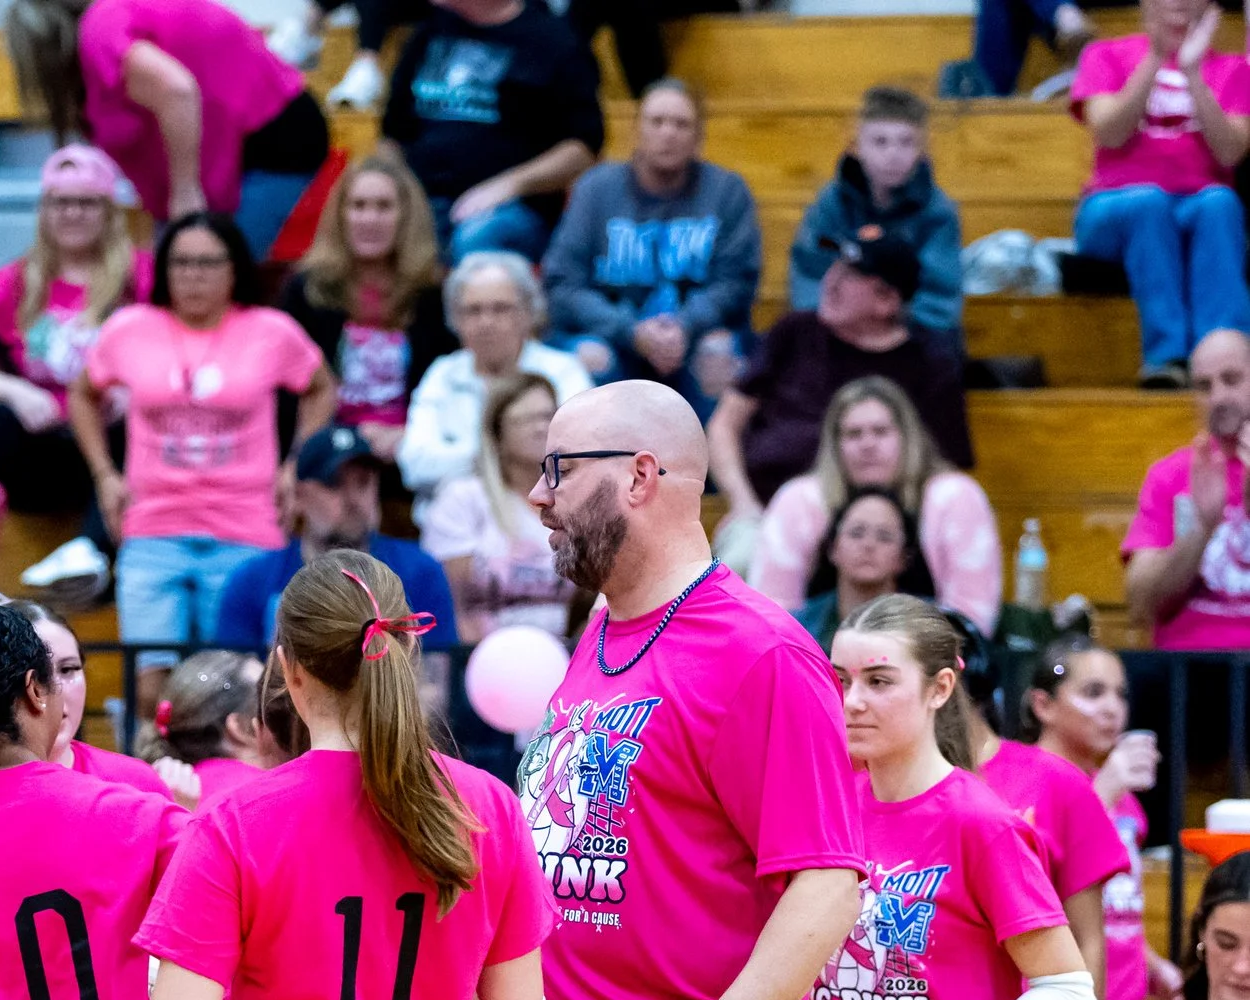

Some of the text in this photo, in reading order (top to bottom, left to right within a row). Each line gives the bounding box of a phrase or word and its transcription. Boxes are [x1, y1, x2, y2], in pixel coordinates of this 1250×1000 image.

[591, 697, 663, 739] MOTT
[612, 747, 631, 796] CORSAIRS
[581, 835, 628, 856] 2026
[538, 851, 628, 904] INK
[881, 865, 951, 899] MOTT
[563, 908, 582, 922] FOR
[583, 910, 589, 923] A
[885, 978, 928, 992] 2026
